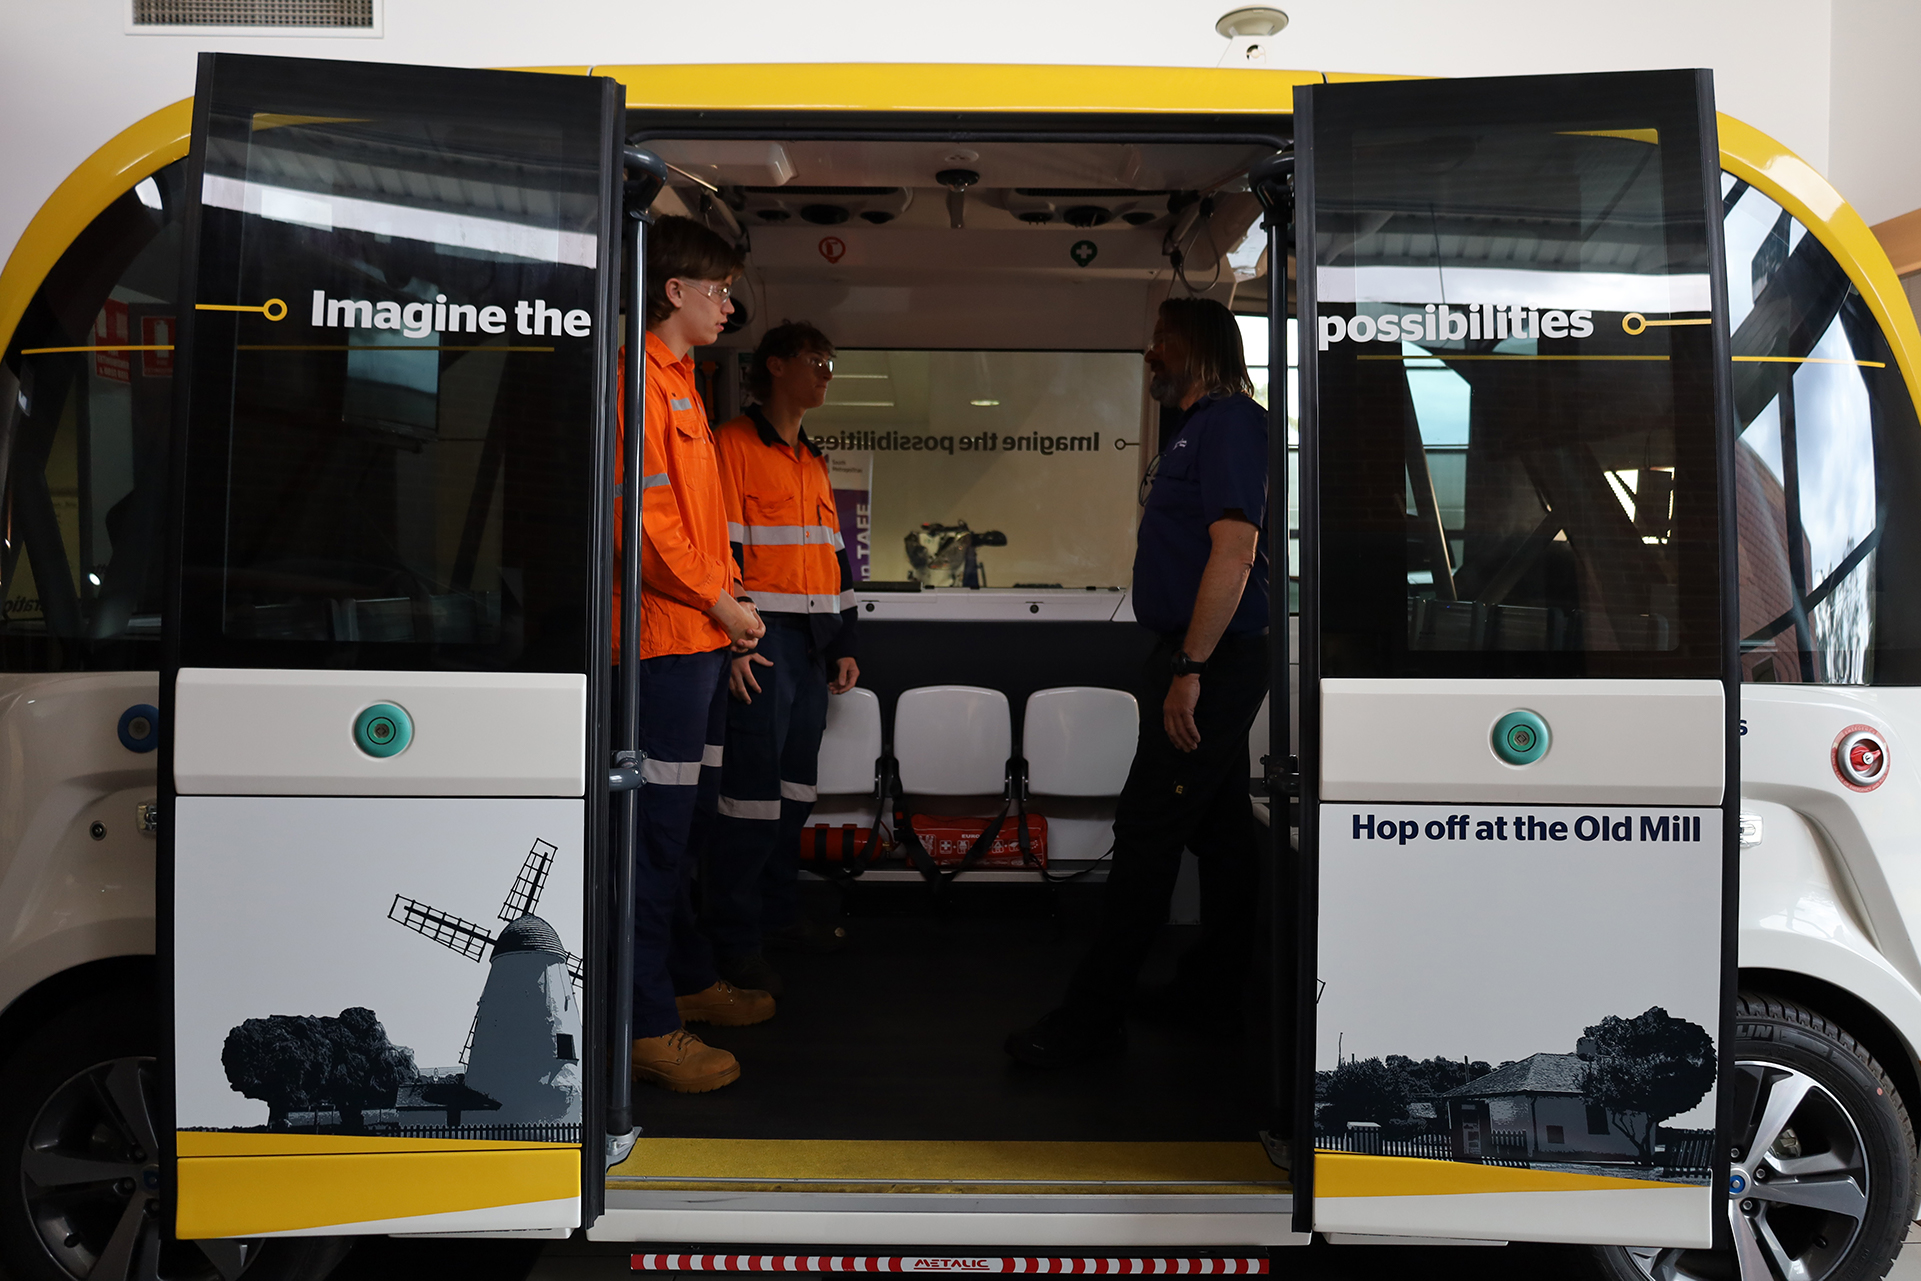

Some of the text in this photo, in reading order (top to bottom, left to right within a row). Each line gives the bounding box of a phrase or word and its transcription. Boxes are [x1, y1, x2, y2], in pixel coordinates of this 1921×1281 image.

[311, 289, 592, 339] Imagine the
[1317, 302, 1595, 351] possibilities
[856, 503, 871, 560] TAFE
[1352, 814, 1701, 845] Hop off at the Old Mill
[914, 1259, 989, 1268] METALIC
